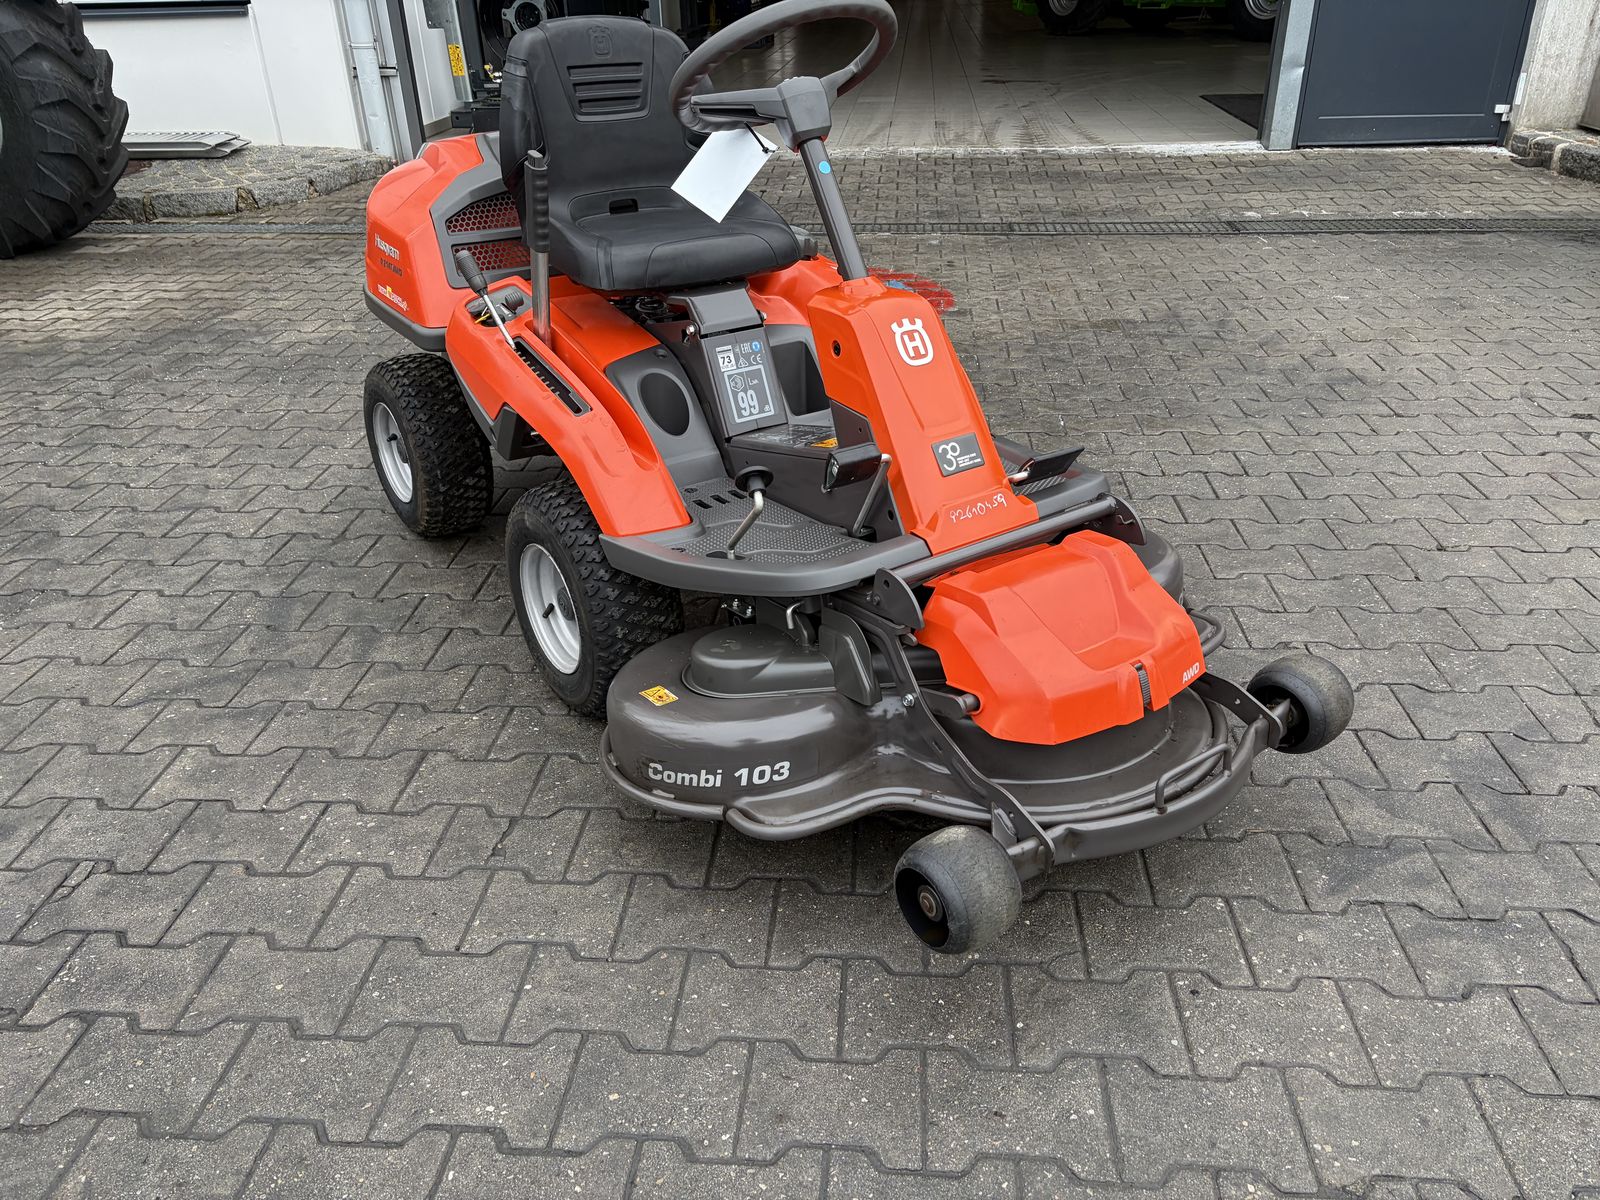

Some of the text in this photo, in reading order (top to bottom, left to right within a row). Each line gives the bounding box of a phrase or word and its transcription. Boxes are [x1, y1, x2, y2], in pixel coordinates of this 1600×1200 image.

[720, 355, 732, 366] 73
[737, 389, 759, 416] 99
[1182, 662, 1200, 685] AWD
[648, 761, 791, 788] Combi 103
